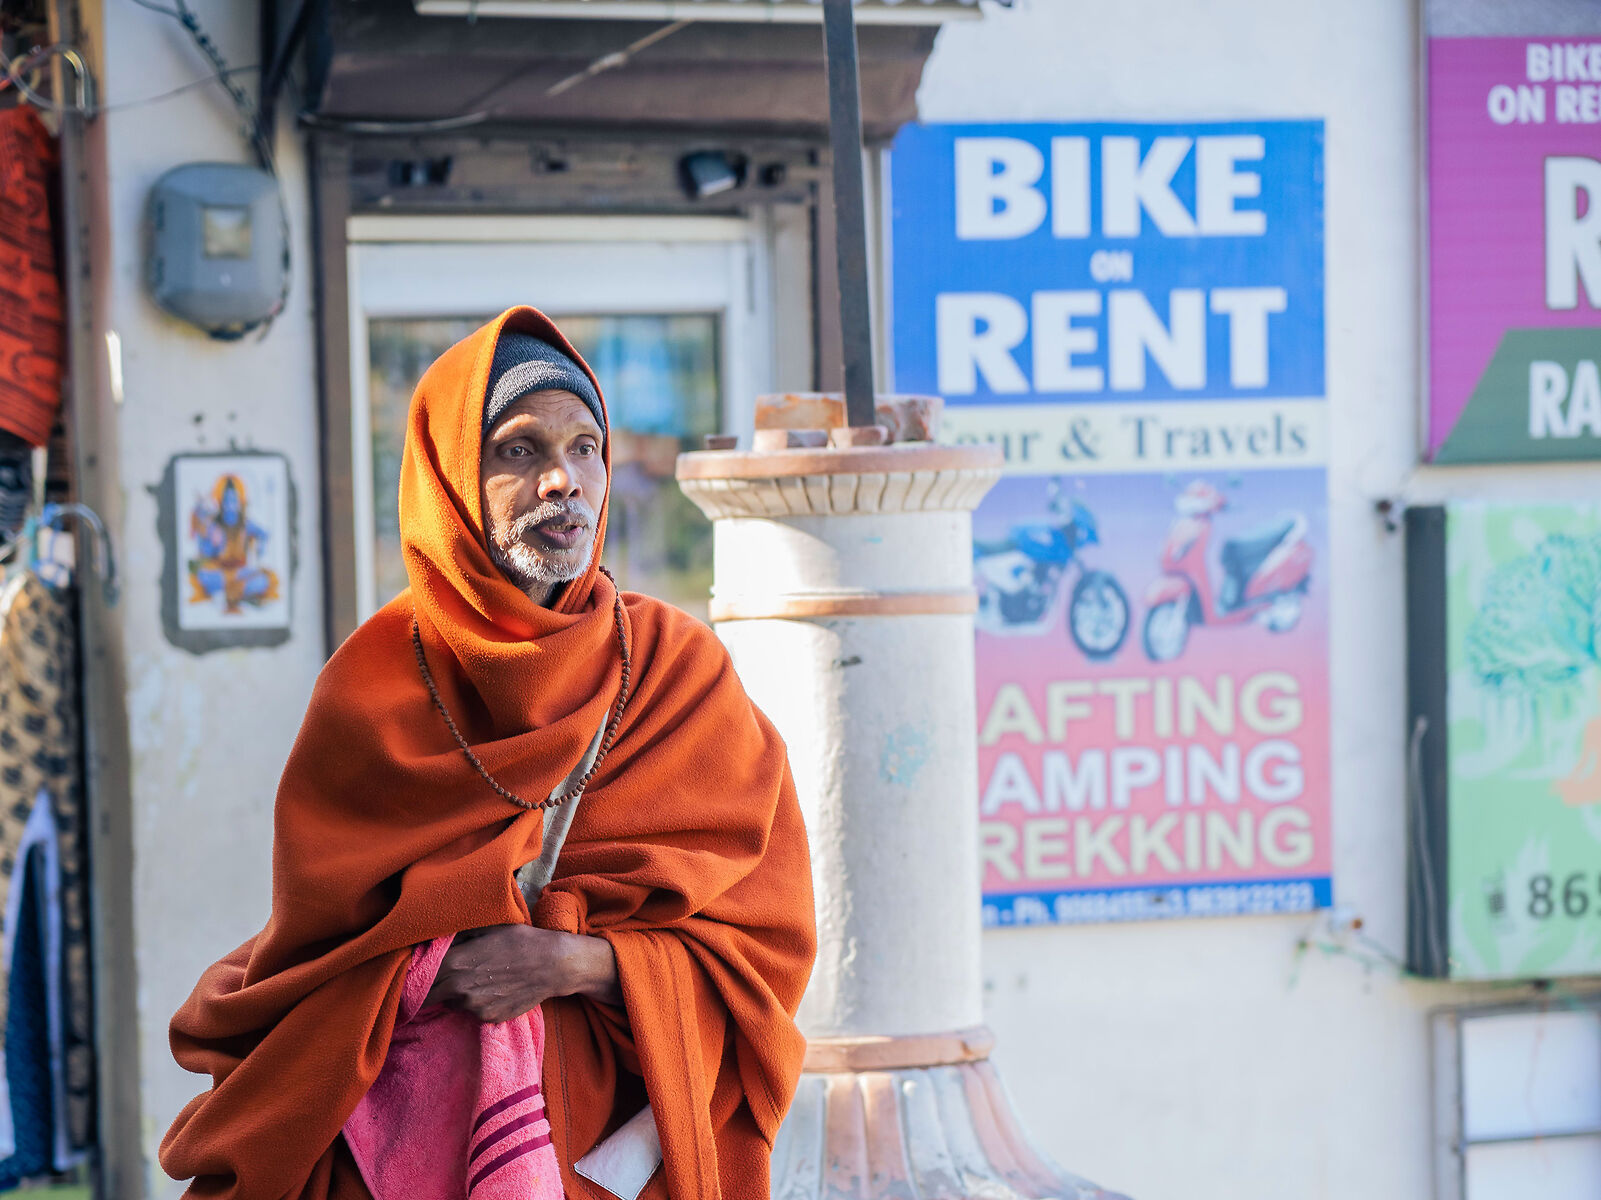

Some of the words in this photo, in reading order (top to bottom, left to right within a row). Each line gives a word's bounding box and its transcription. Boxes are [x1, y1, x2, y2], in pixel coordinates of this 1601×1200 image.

[1486, 84, 1546, 125] ON
[1555, 84, 1601, 124] RE
[954, 135, 1266, 240] BIKE
[1090, 250, 1133, 282] ON
[936, 287, 1287, 395] RENT
[1060, 413, 1101, 461] &
[1122, 411, 1307, 459] Travels
[977, 670, 1303, 746] AFTING
[980, 739, 1304, 815] AMPING
[979, 806, 1314, 882] REKKING
[1527, 871, 1601, 920] 86
